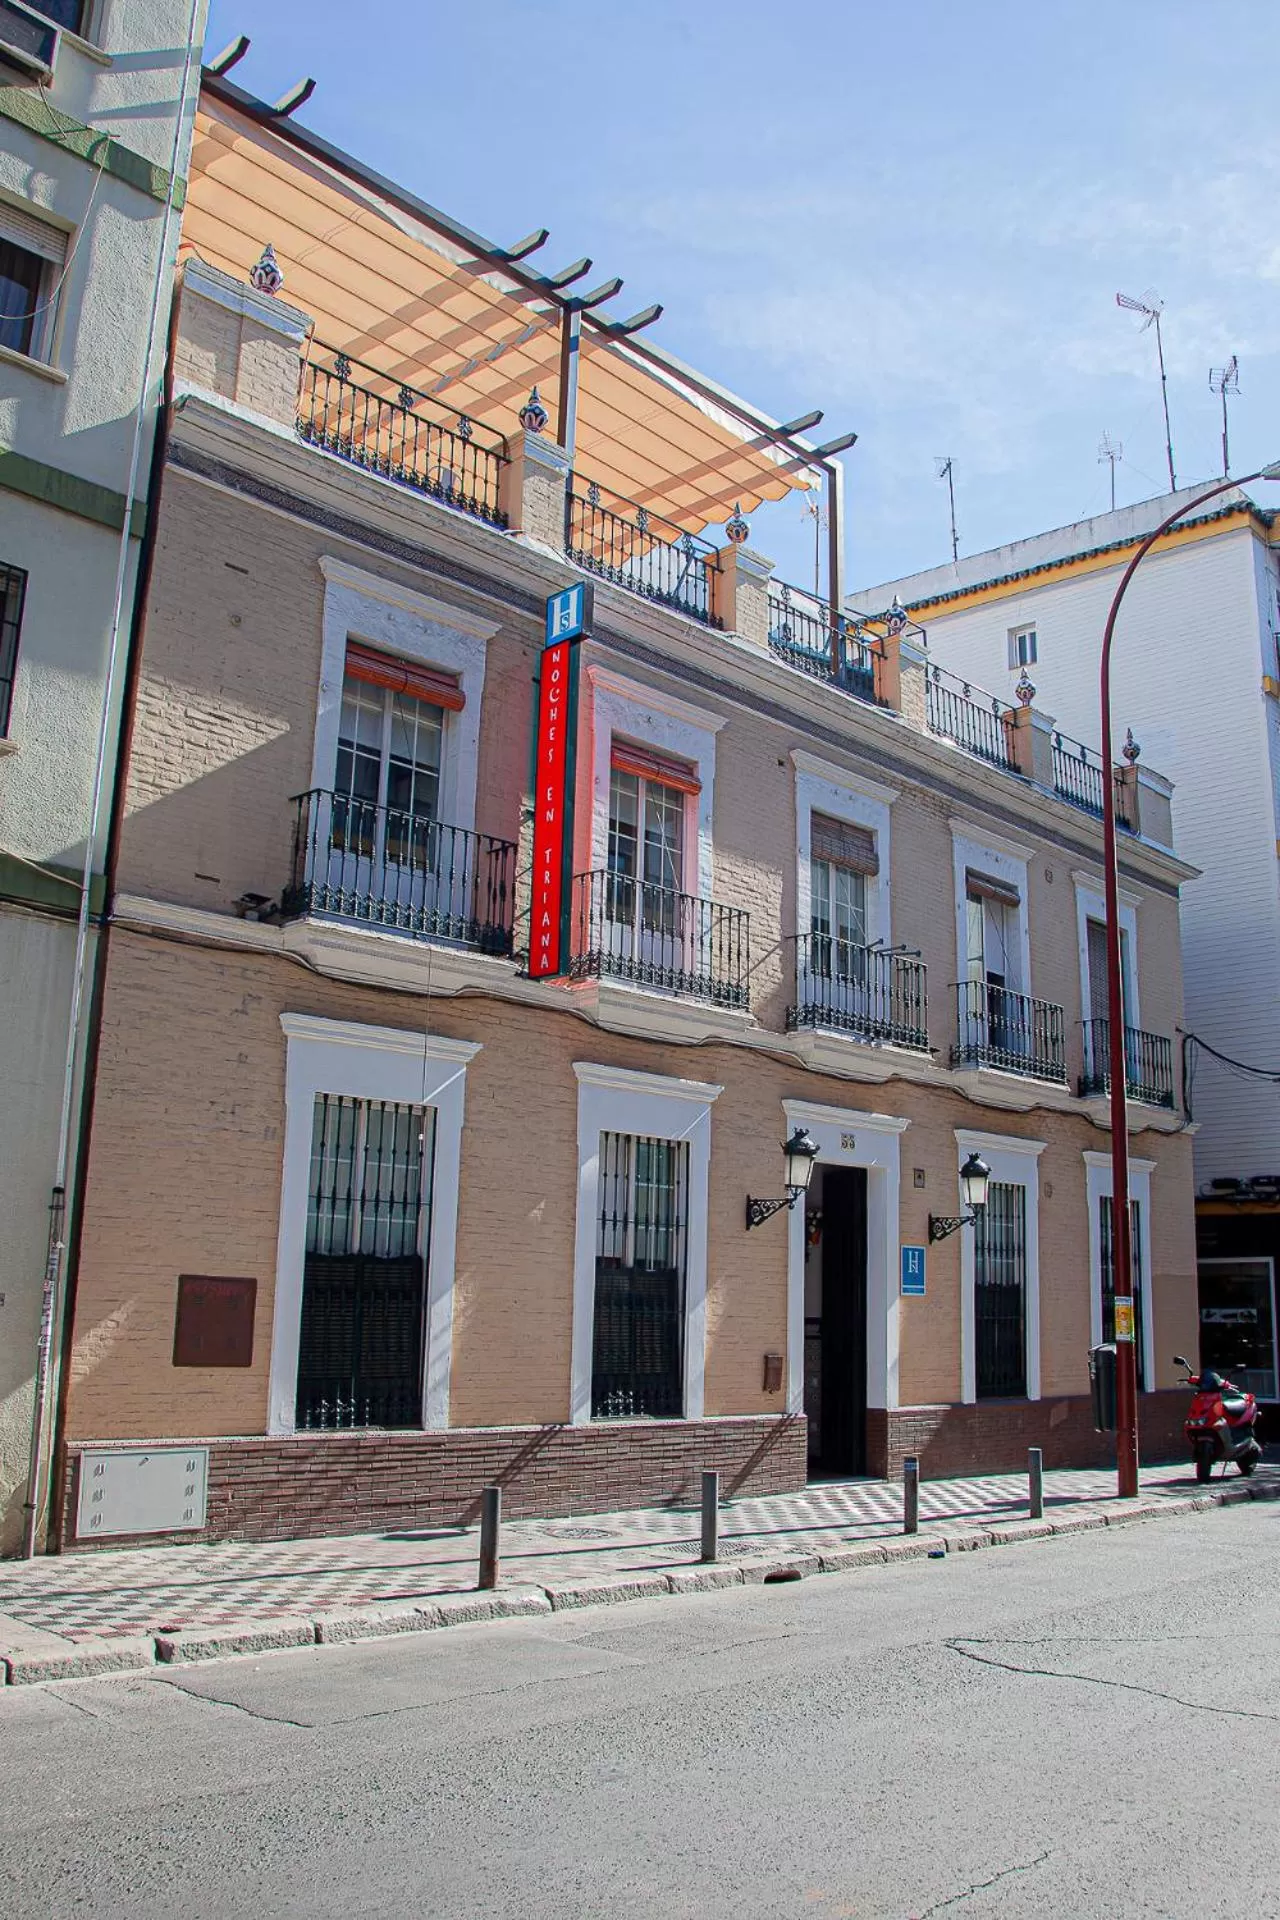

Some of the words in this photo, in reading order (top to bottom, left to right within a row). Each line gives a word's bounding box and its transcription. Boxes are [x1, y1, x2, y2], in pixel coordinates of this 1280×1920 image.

[551, 588, 580, 637] H
[548, 649, 560, 763] NOCHES
[545, 786, 554, 823] EN
[540, 847, 553, 970] TRIANA
